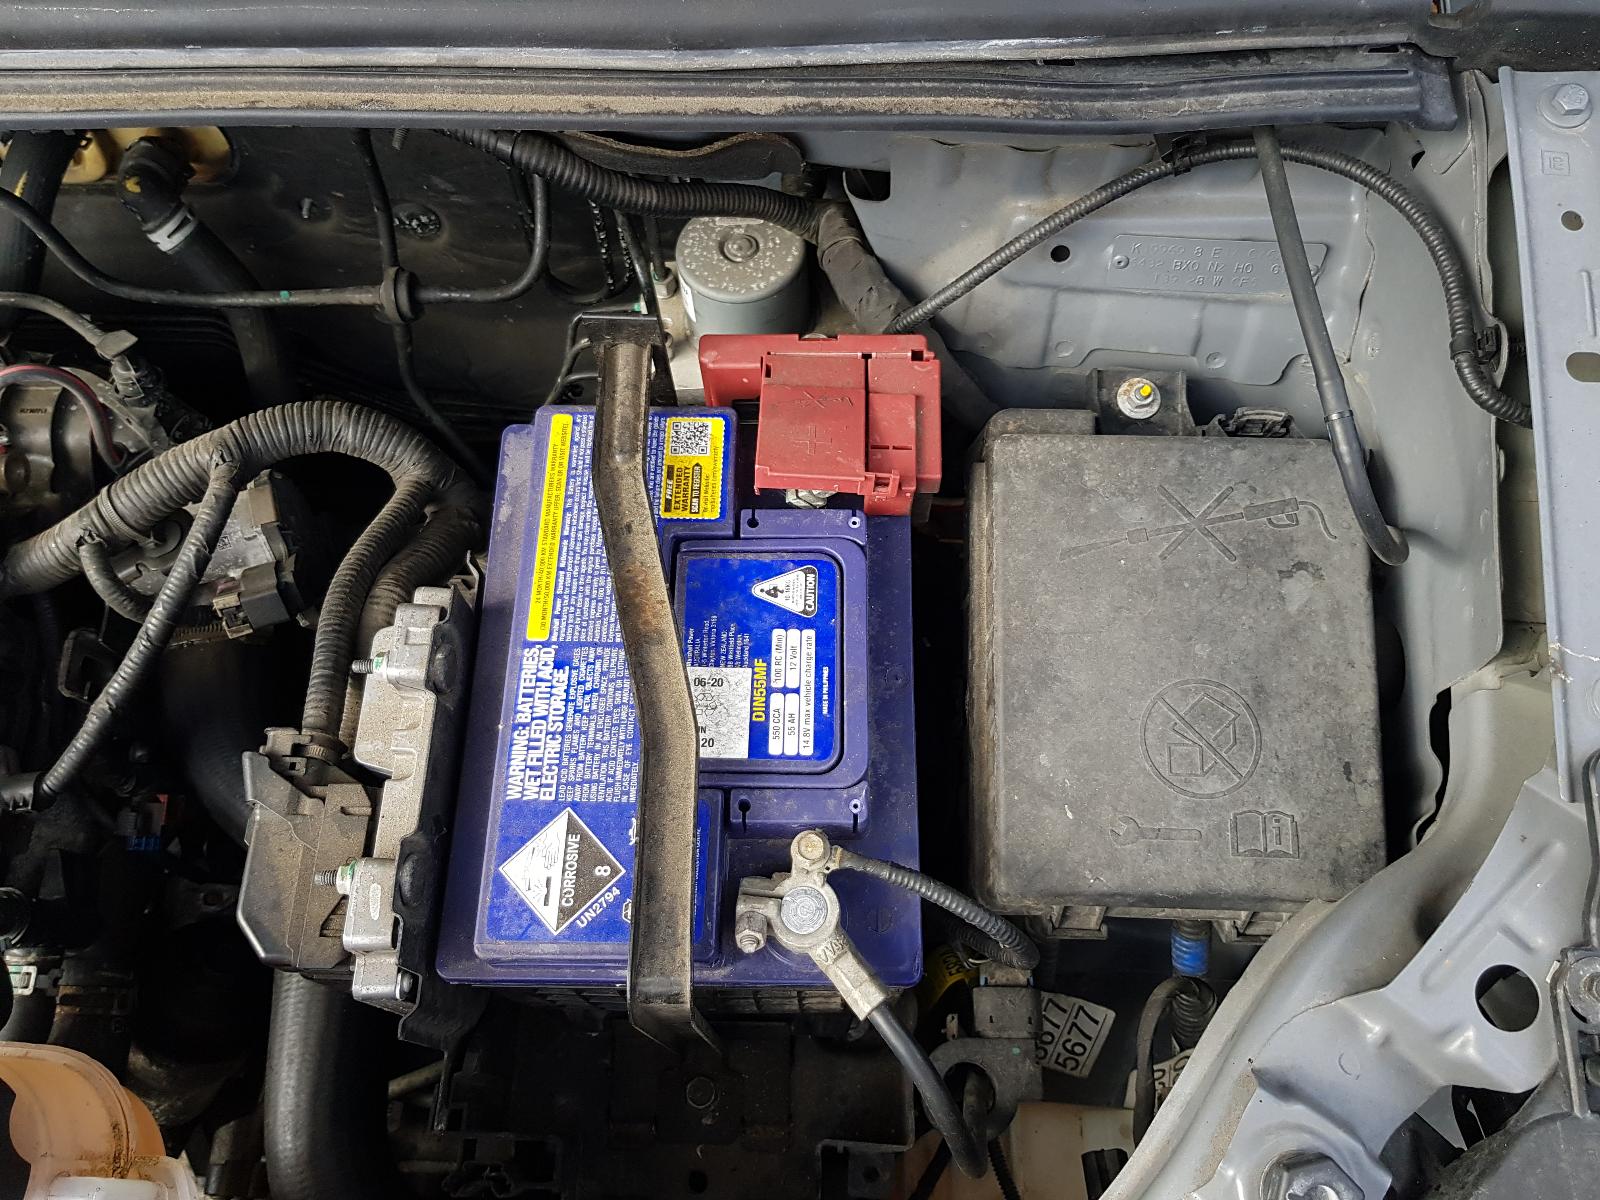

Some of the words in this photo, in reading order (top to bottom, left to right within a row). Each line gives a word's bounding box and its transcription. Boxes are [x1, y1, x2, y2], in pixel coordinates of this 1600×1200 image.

[674, 467, 683, 510] EXTENDED
[682, 466, 691, 512] WARRANTY
[692, 466, 701, 490] REGISTER
[692, 498, 700, 512] SCAN
[549, 511, 559, 540] WARRANTY
[546, 541, 556, 570] EXTENDED
[806, 574, 816, 611] CAUTION
[588, 646, 596, 663] AWAY
[596, 646, 604, 656] OR
[775, 634, 784, 654] (Min)
[537, 645, 558, 680] ACID,
[578, 646, 589, 681] CIGARETTES
[602, 647, 611, 671] PROVIDE
[609, 648, 618, 678] SULPHURIC
[774, 656, 782, 666] RC
[790, 661, 797, 670] 12
[804, 652, 813, 678] charge
[516, 644, 542, 723] BATTERIES,
[569, 669, 578, 700] EXPLOSIVE
[585, 664, 594, 691] OBJECTS
[593, 660, 602, 689] CHARGING
[615, 680, 623, 688] OR
[694, 678, 724, 688] 06-20
[533, 682, 551, 717] WITH
[548, 666, 569, 731] STORAGE.
[575, 684, 585, 710] LIGHTED
[591, 692, 599, 710] WHEN
[606, 682, 615, 711] CONTAINS
[752, 658, 767, 722] DIN55MF
[803, 680, 812, 706] vehicle
[583, 693, 591, 712] METAL
[597, 697, 606, 728] ENCLOSED
[620, 705, 628, 724] LARGE
[565, 702, 575, 732] GENERATE
[574, 713, 582, 726] AND
[581, 716, 589, 730] KEEP
[603, 714, 612, 740] BATTERY
[626, 709, 636, 739] CONTACT
[788, 713, 796, 724] AH
[526, 719, 547, 766] FILLED
[571, 730, 580, 754] FLAMES
[595, 732, 603, 740] AN
[610, 726, 619, 758] CONTACTS
[619, 725, 627, 740] WITH
[700, 738, 714, 748] 20
[772, 726, 780, 740] 550
[788, 726, 796, 736] 55
[802, 728, 810, 749] 14.8V
[562, 734, 572, 766] BATTERIES
[601, 744, 609, 758] THIS
[615, 742, 625, 781] IMMEDIATELY
[506, 726, 530, 800] WARNING:
[540, 735, 561, 800] ELECTRIC
[576, 763, 584, 781] FROM
[584, 752, 593, 779] BATTERY
[592, 752, 601, 780] BATTERY
[608, 760, 616, 774] ACID
[624, 759, 632, 768] OF
[523, 768, 542, 800] WET
[560, 768, 568, 783] ACID
[622, 773, 630, 791] CASE
[558, 785, 567, 801] LEAD
[566, 786, 574, 802] KEEP
[574, 784, 582, 802] AWAY
[582, 784, 590, 802] FROM
[589, 782, 598, 802] USING
[614, 782, 622, 802] FLUSH
[562, 833, 580, 907] CORROSIVE
[594, 865, 611, 877] 8
[576, 886, 621, 928] UN2794
[1054, 1004, 1100, 1072] 5677
